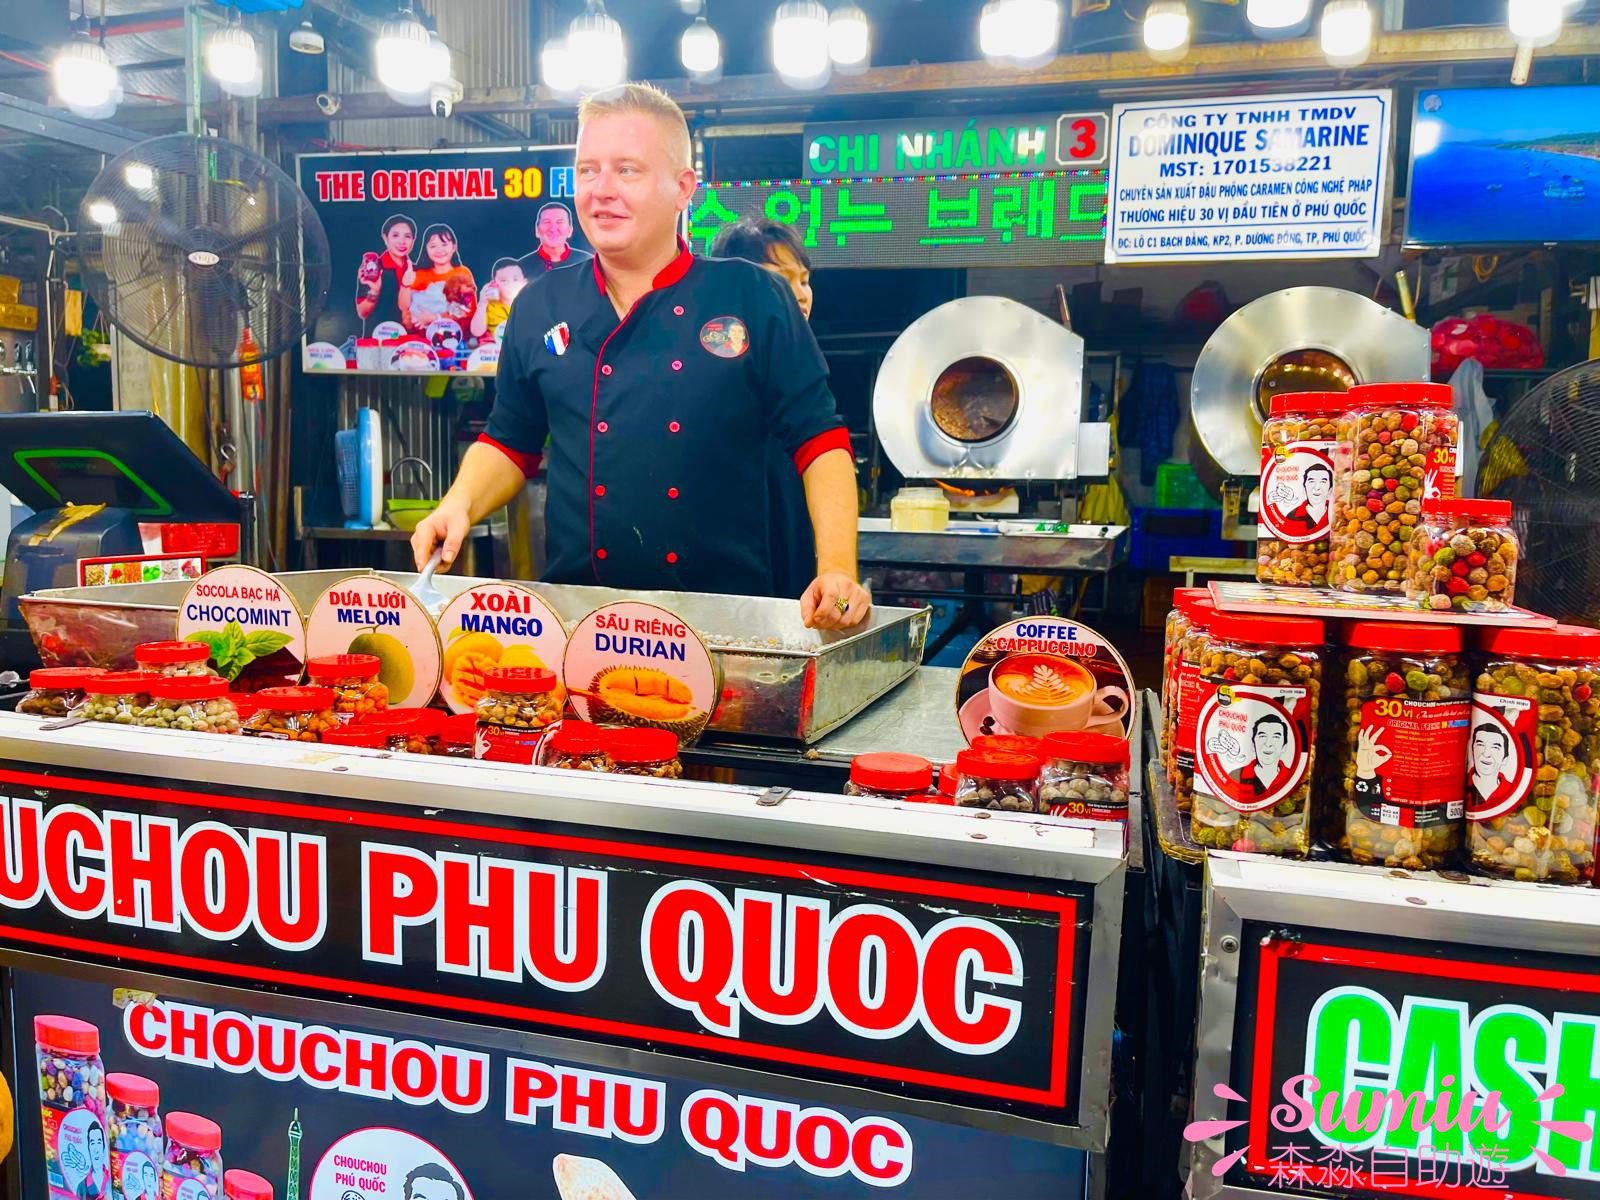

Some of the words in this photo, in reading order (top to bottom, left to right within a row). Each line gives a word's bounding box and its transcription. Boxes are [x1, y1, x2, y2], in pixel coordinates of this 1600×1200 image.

[1204, 112, 1228, 126] TY
[1236, 110, 1290, 124] TNHH
[1298, 106, 1357, 120] TMDV
[809, 134, 880, 173] CHI
[896, 119, 1047, 170] NHÁNH
[1069, 119, 1096, 158] 3
[1129, 130, 1247, 157] DOMINIQUE
[1255, 124, 1370, 150] SARINE
[1160, 161, 1204, 177] MST:
[316, 170, 365, 201] THE
[371, 168, 497, 200] ORIGINAL
[503, 167, 542, 199] 30
[1250, 182, 1292, 197] CARAMEN
[1200, 208, 1214, 221] 30
[1218, 207, 1229, 223] VỊ
[1434, 447, 1449, 465] 30
[196, 584, 239, 598] SOCOLA
[241, 587, 263, 603] BẠC
[329, 590, 362, 606] DƯA
[367, 591, 406, 609] LƯỚI
[470, 590, 530, 614] XOÀI
[187, 604, 291, 627] CHOCOMINT
[337, 608, 400, 626] MELON
[461, 613, 543, 637] MANGO
[634, 618, 686, 638] RIÊNG
[1016, 623, 1077, 640] COFFEE
[595, 633, 685, 661] DURIAN
[996, 637, 1097, 657] CAPPUCCINO
[1374, 698, 1402, 717] 30
[488, 725, 500, 736] 30
[1068, 801, 1085, 814] 30
[361, 841, 608, 992] PHU
[641, 880, 1024, 1055] QUOC
[123, 1000, 490, 1114] CHOUCHOU
[506, 1057, 666, 1144] PHU
[680, 1089, 913, 1187] QUOC
[334, 1154, 387, 1175] CHOUCHOU
[335, 1172, 355, 1187] PHÚ
[358, 1176, 386, 1193] QUỐC
